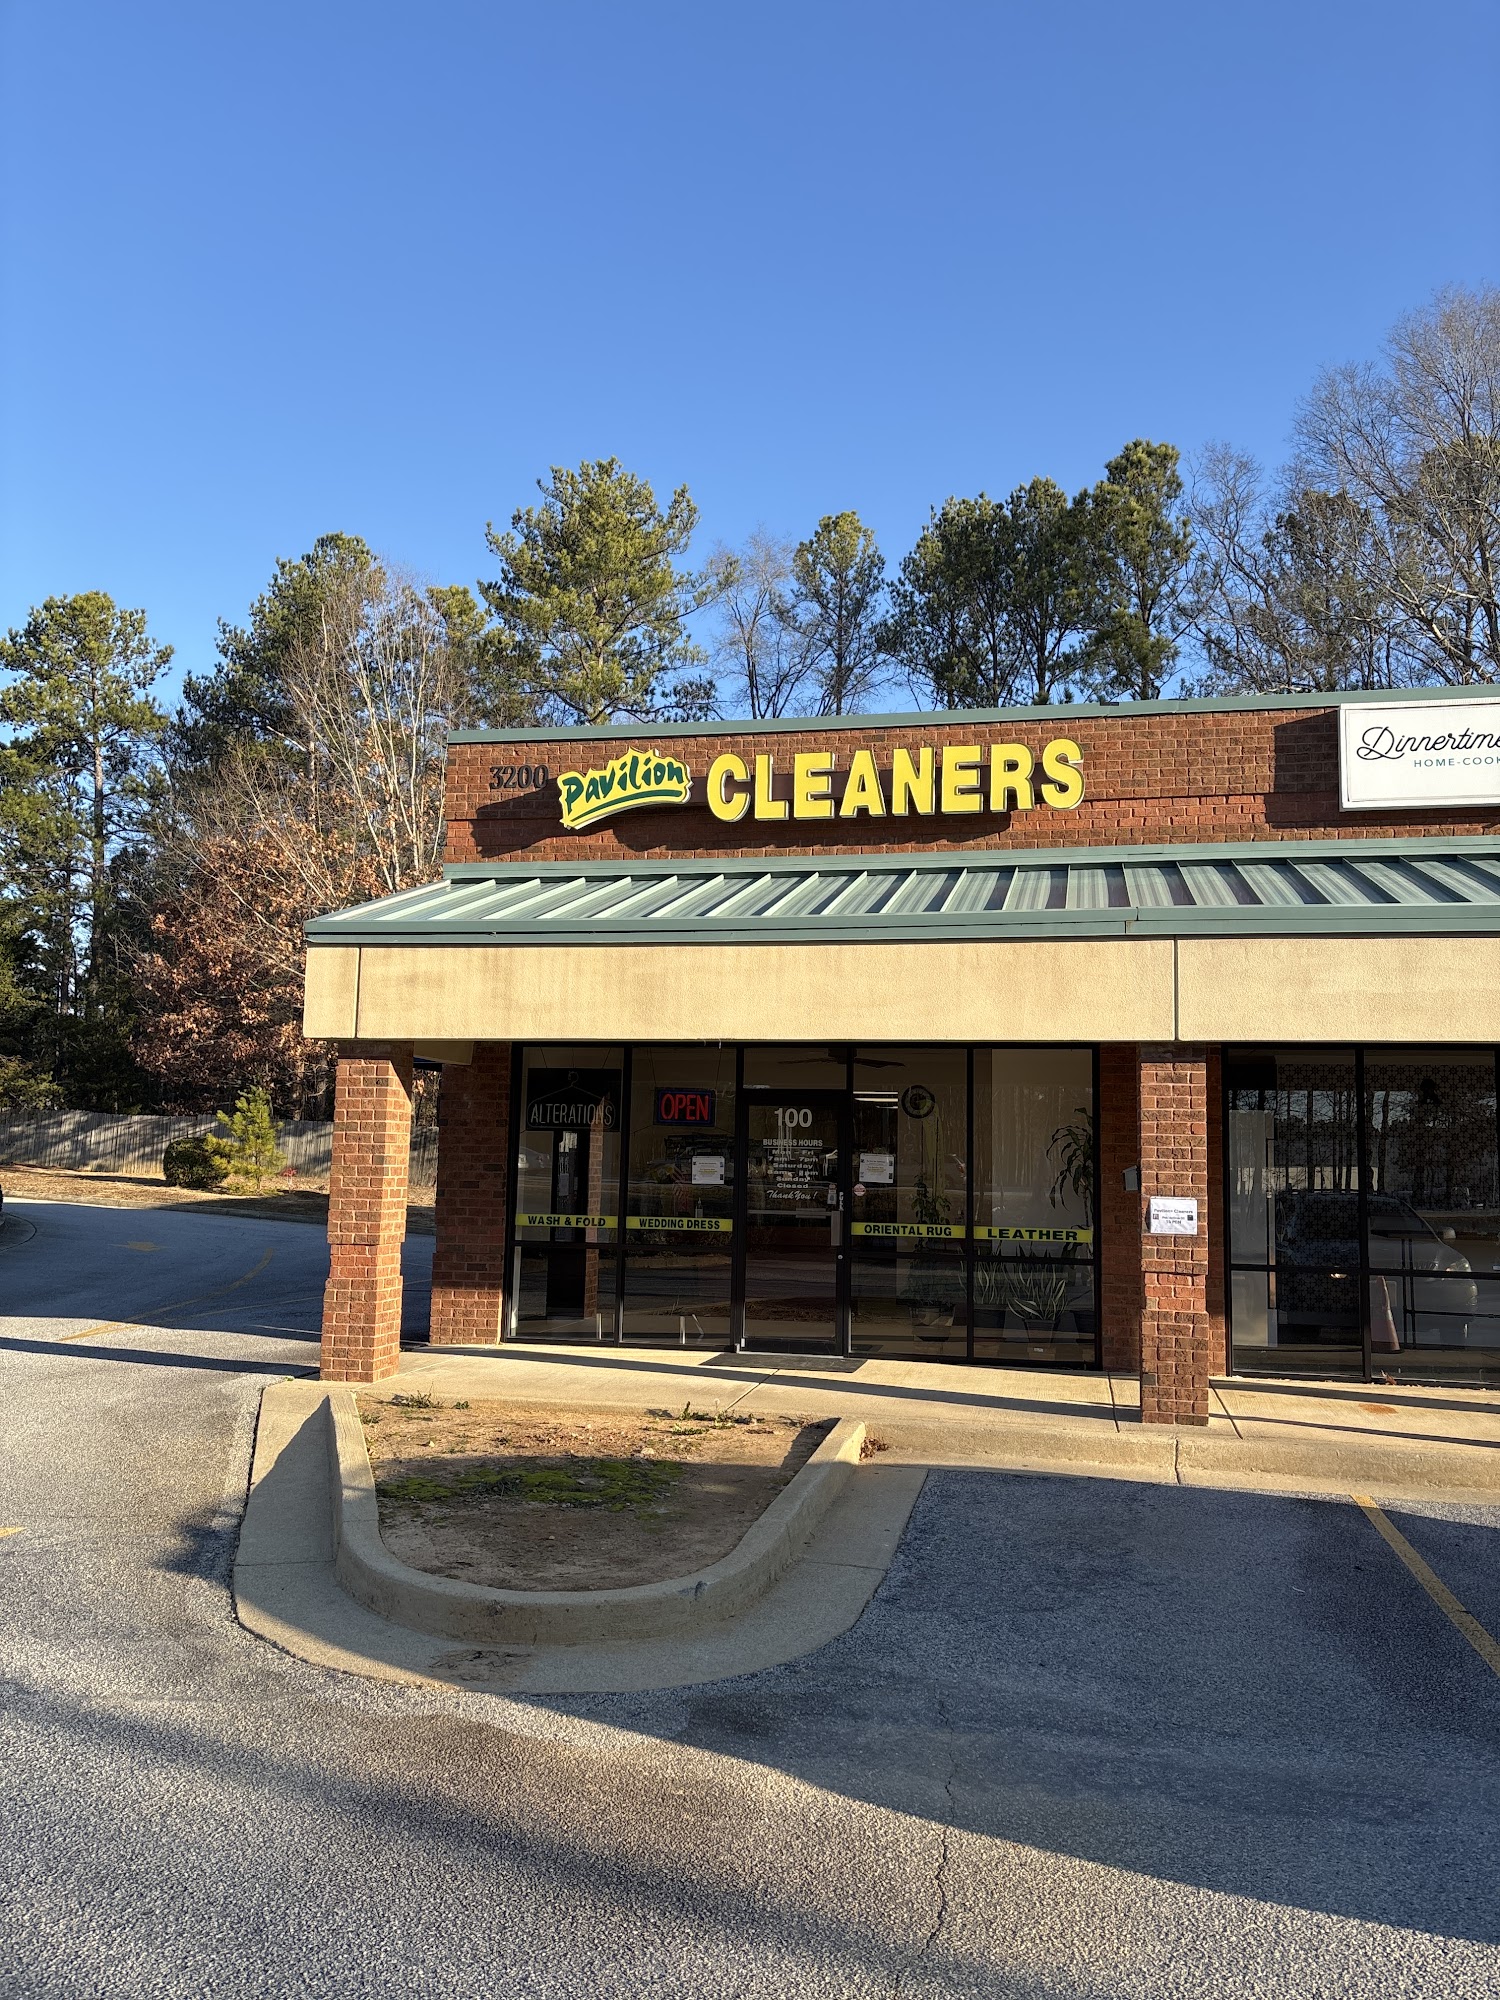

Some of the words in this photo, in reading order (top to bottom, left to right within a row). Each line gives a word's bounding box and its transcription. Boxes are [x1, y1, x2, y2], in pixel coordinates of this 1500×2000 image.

[489, 764, 549, 790] 3200
[562, 755, 684, 816] Pavilion
[706, 738, 1085, 822] CLEANERS
[660, 1093, 709, 1121] OPEN
[530, 1103, 613, 1126] ALTERATIONS
[774, 1107, 813, 1128] 100
[798, 1139, 823, 1147] HOURS
[767, 1190, 794, 1200] Thank
[527, 1215, 561, 1227] WASH
[564, 1216, 572, 1227] &
[575, 1217, 606, 1228] FOLD
[639, 1218, 684, 1229] WEDDING
[686, 1219, 720, 1230] DRESS
[864, 1224, 922, 1236] ORIENTAL
[926, 1226, 952, 1237] RUG
[987, 1228, 1079, 1241] LEATHER
